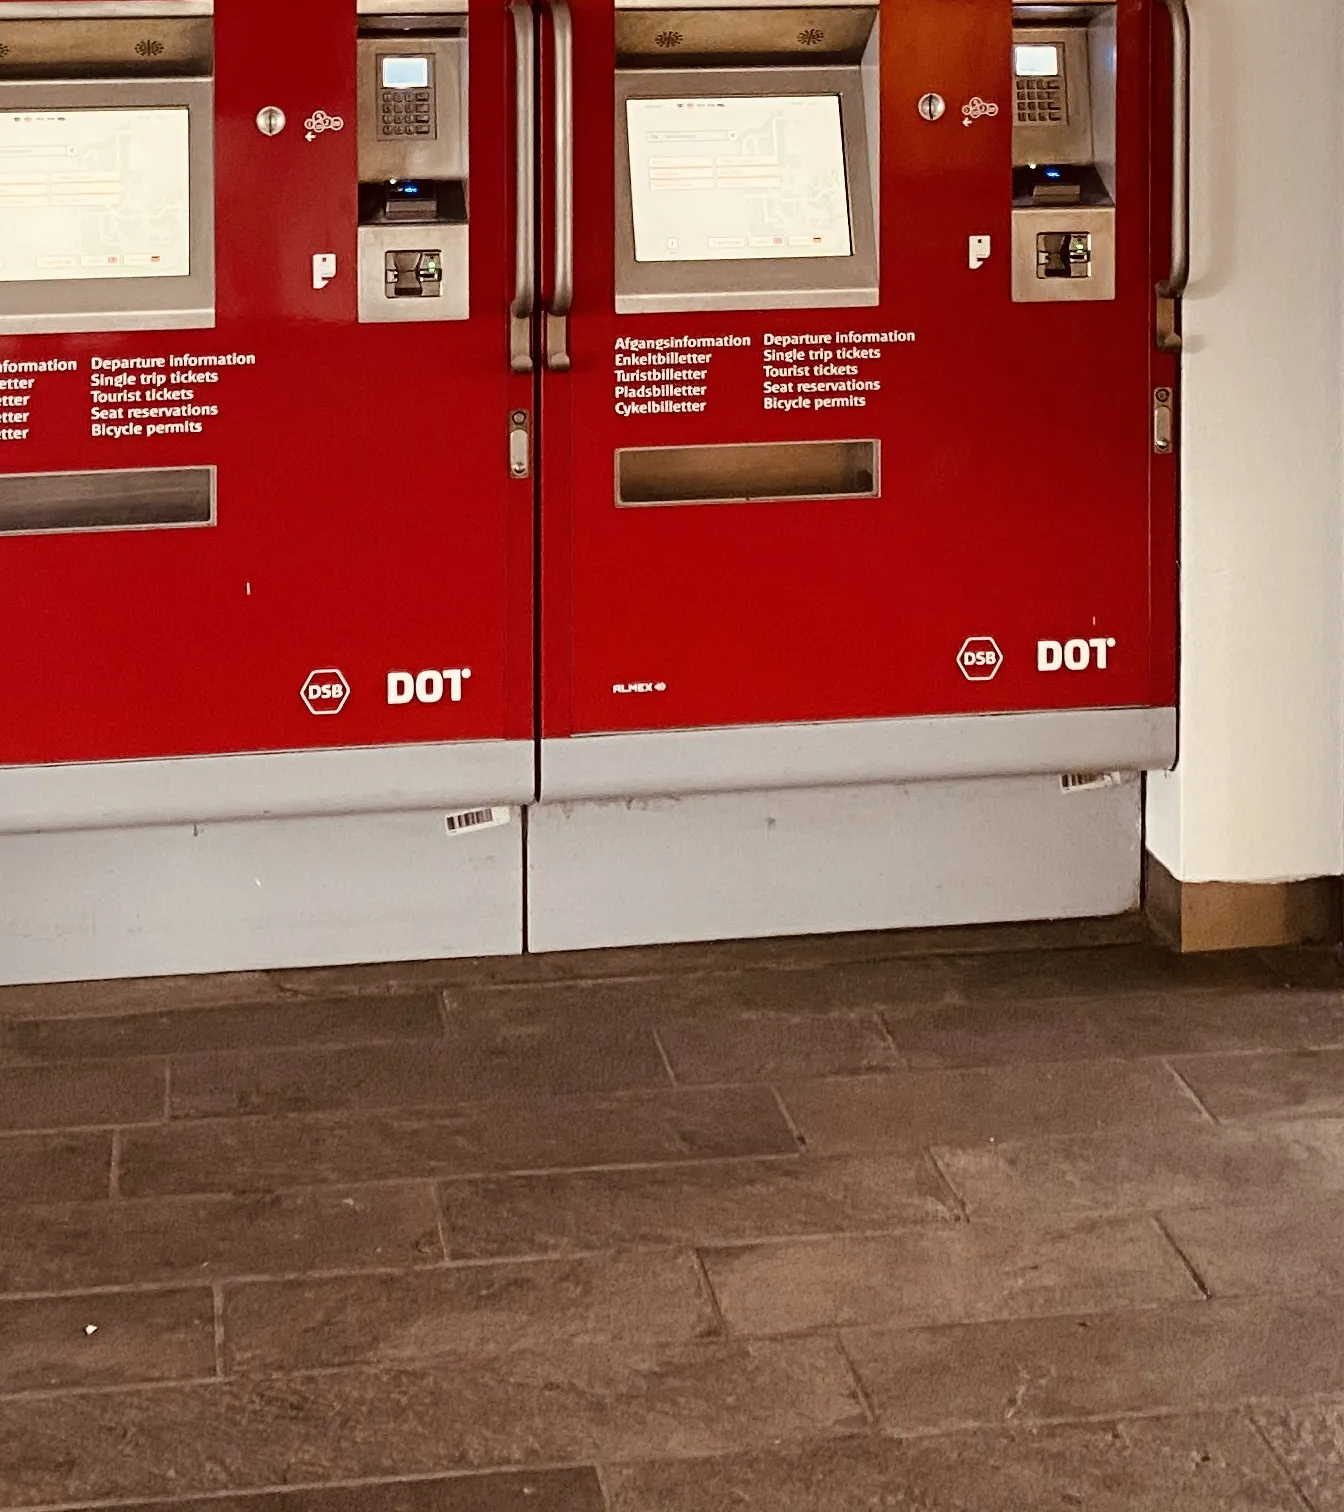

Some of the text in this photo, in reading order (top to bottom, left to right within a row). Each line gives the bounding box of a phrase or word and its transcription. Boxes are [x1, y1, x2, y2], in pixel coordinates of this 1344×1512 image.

[615, 335, 750, 351] Afgangsinformation
[764, 330, 915, 347] Departure information
[92, 353, 255, 371] Departure information
[616, 352, 712, 366] Enkeltbilletter
[764, 347, 880, 362] Single trip tickets
[614, 368, 707, 382] Turistbilletter
[763, 363, 858, 377] Tourist tickets
[91, 370, 218, 387] Single trip tickets
[764, 379, 880, 393] Seat reservations
[90, 388, 194, 403] Tourist tickets
[615, 384, 707, 398] Pladsbilletter
[615, 400, 706, 416] Cykelbilletter
[764, 395, 865, 410] Bicycle permits
[91, 404, 218, 419] Seat reservations
[92, 421, 202, 437] Bicycle permits
[964, 651, 996, 666] DSB
[1038, 638, 1116, 671] DOT
[308, 684, 343, 699] DSB
[388, 668, 471, 704] DOT
[613, 683, 652, 693] ALMEX
